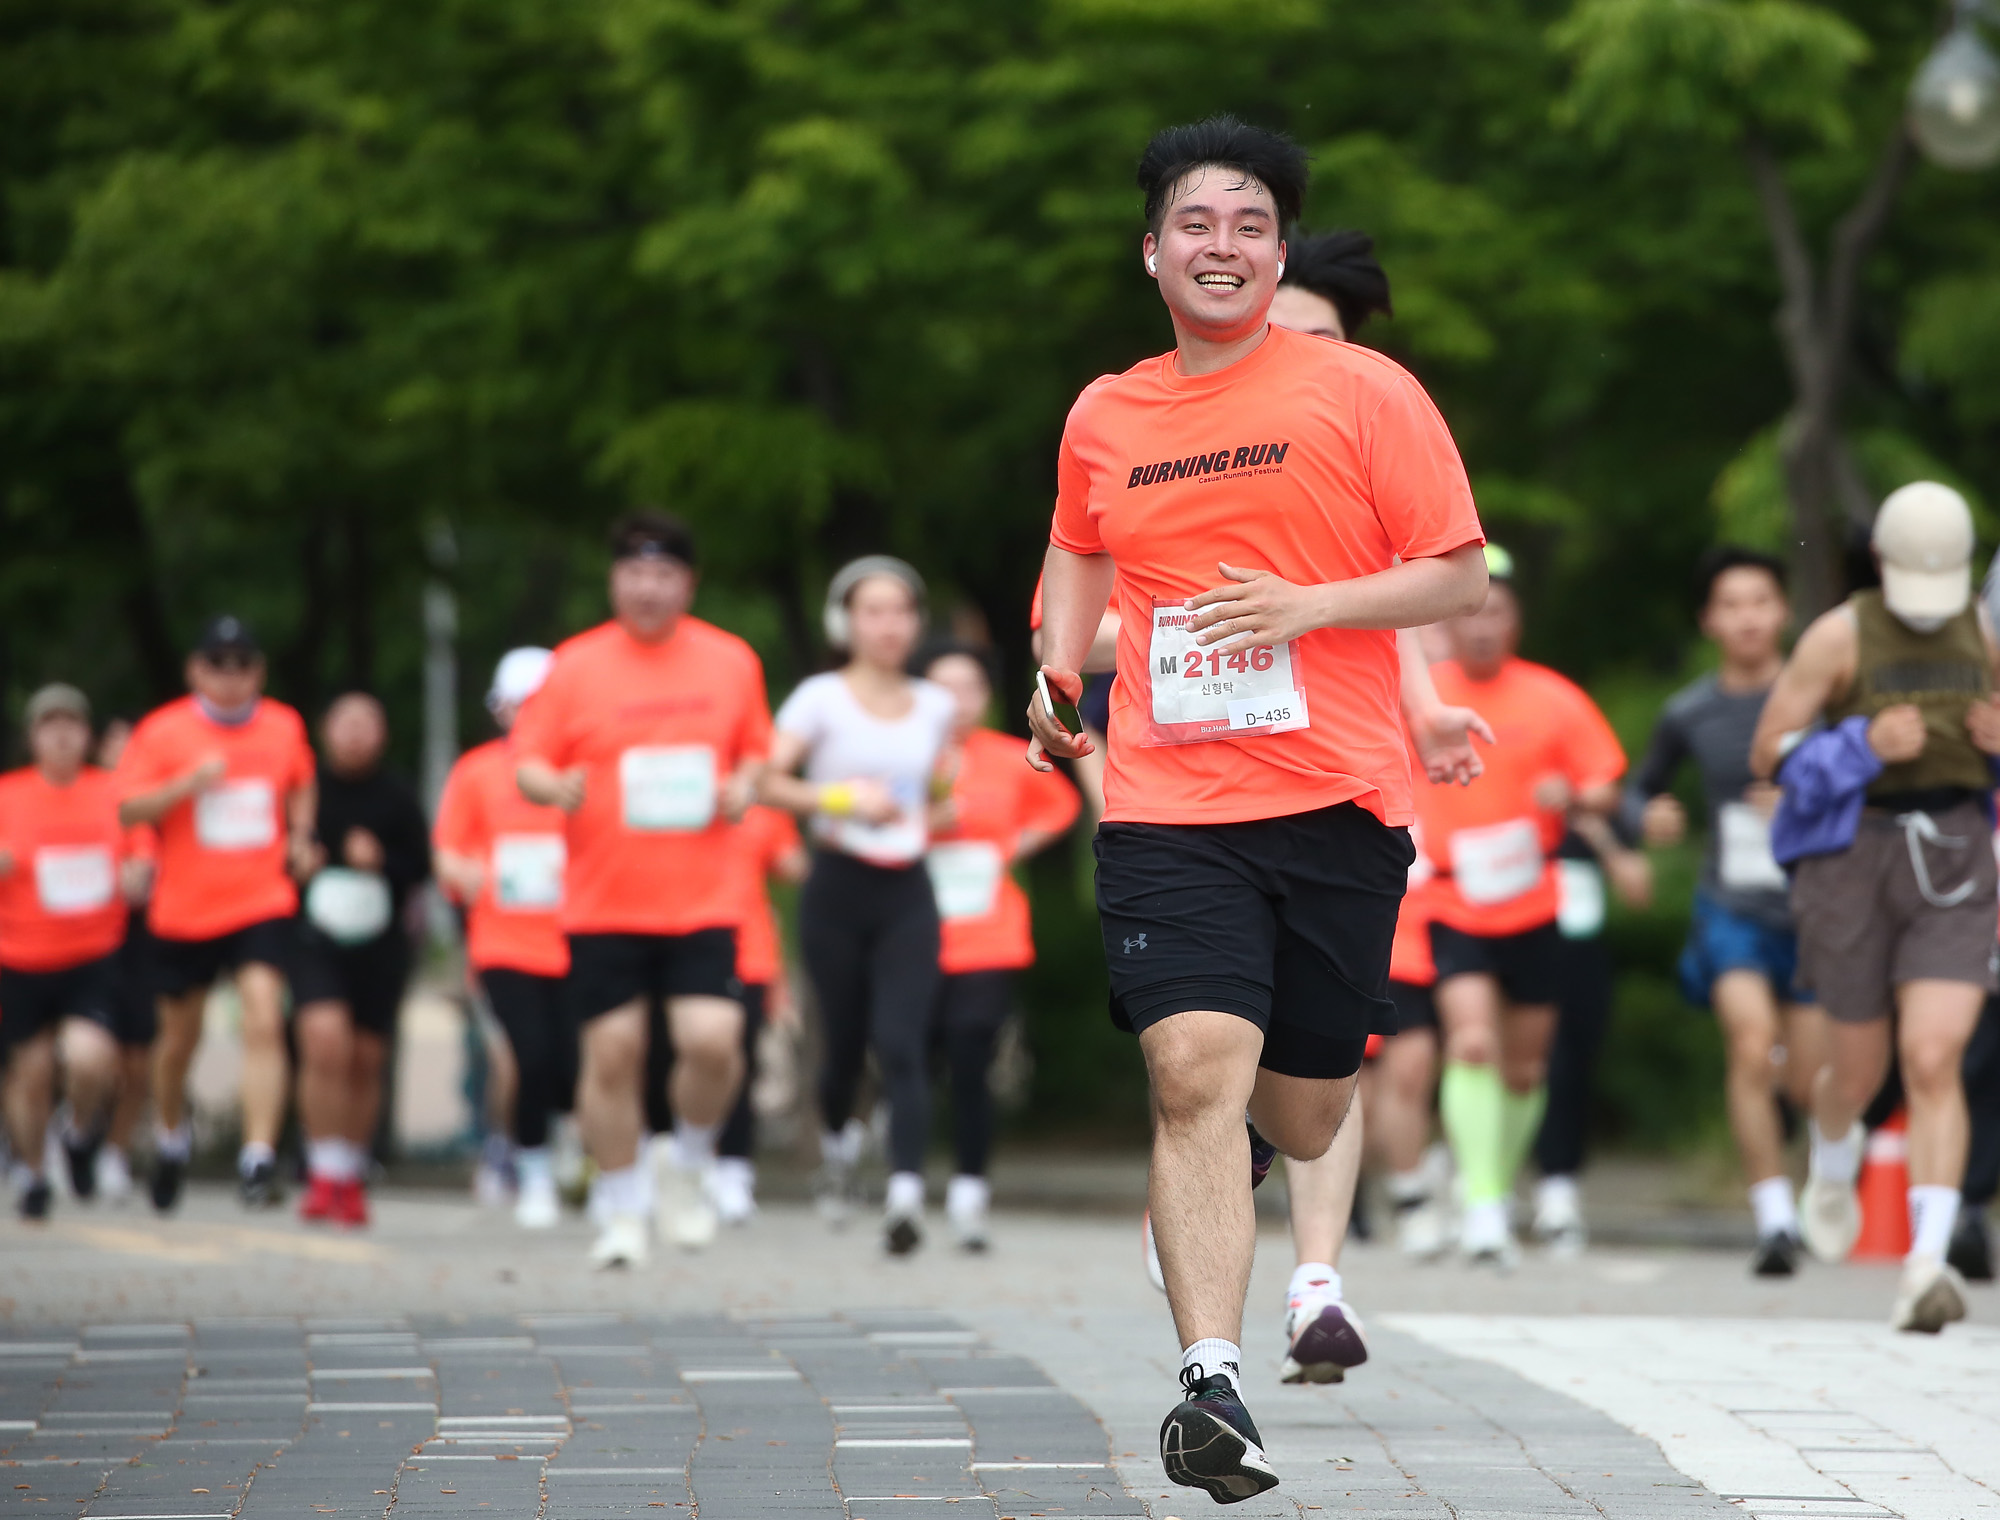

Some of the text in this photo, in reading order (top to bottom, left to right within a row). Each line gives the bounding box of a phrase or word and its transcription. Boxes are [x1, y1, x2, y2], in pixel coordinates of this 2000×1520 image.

[1127, 443, 1289, 489] BURNING RUN
[1198, 467, 1282, 484] Casual Running Festival
[1160, 645, 1274, 678] M 2146
[1202, 682, 1234, 696] 신형탁
[1246, 707, 1291, 725] D-435
